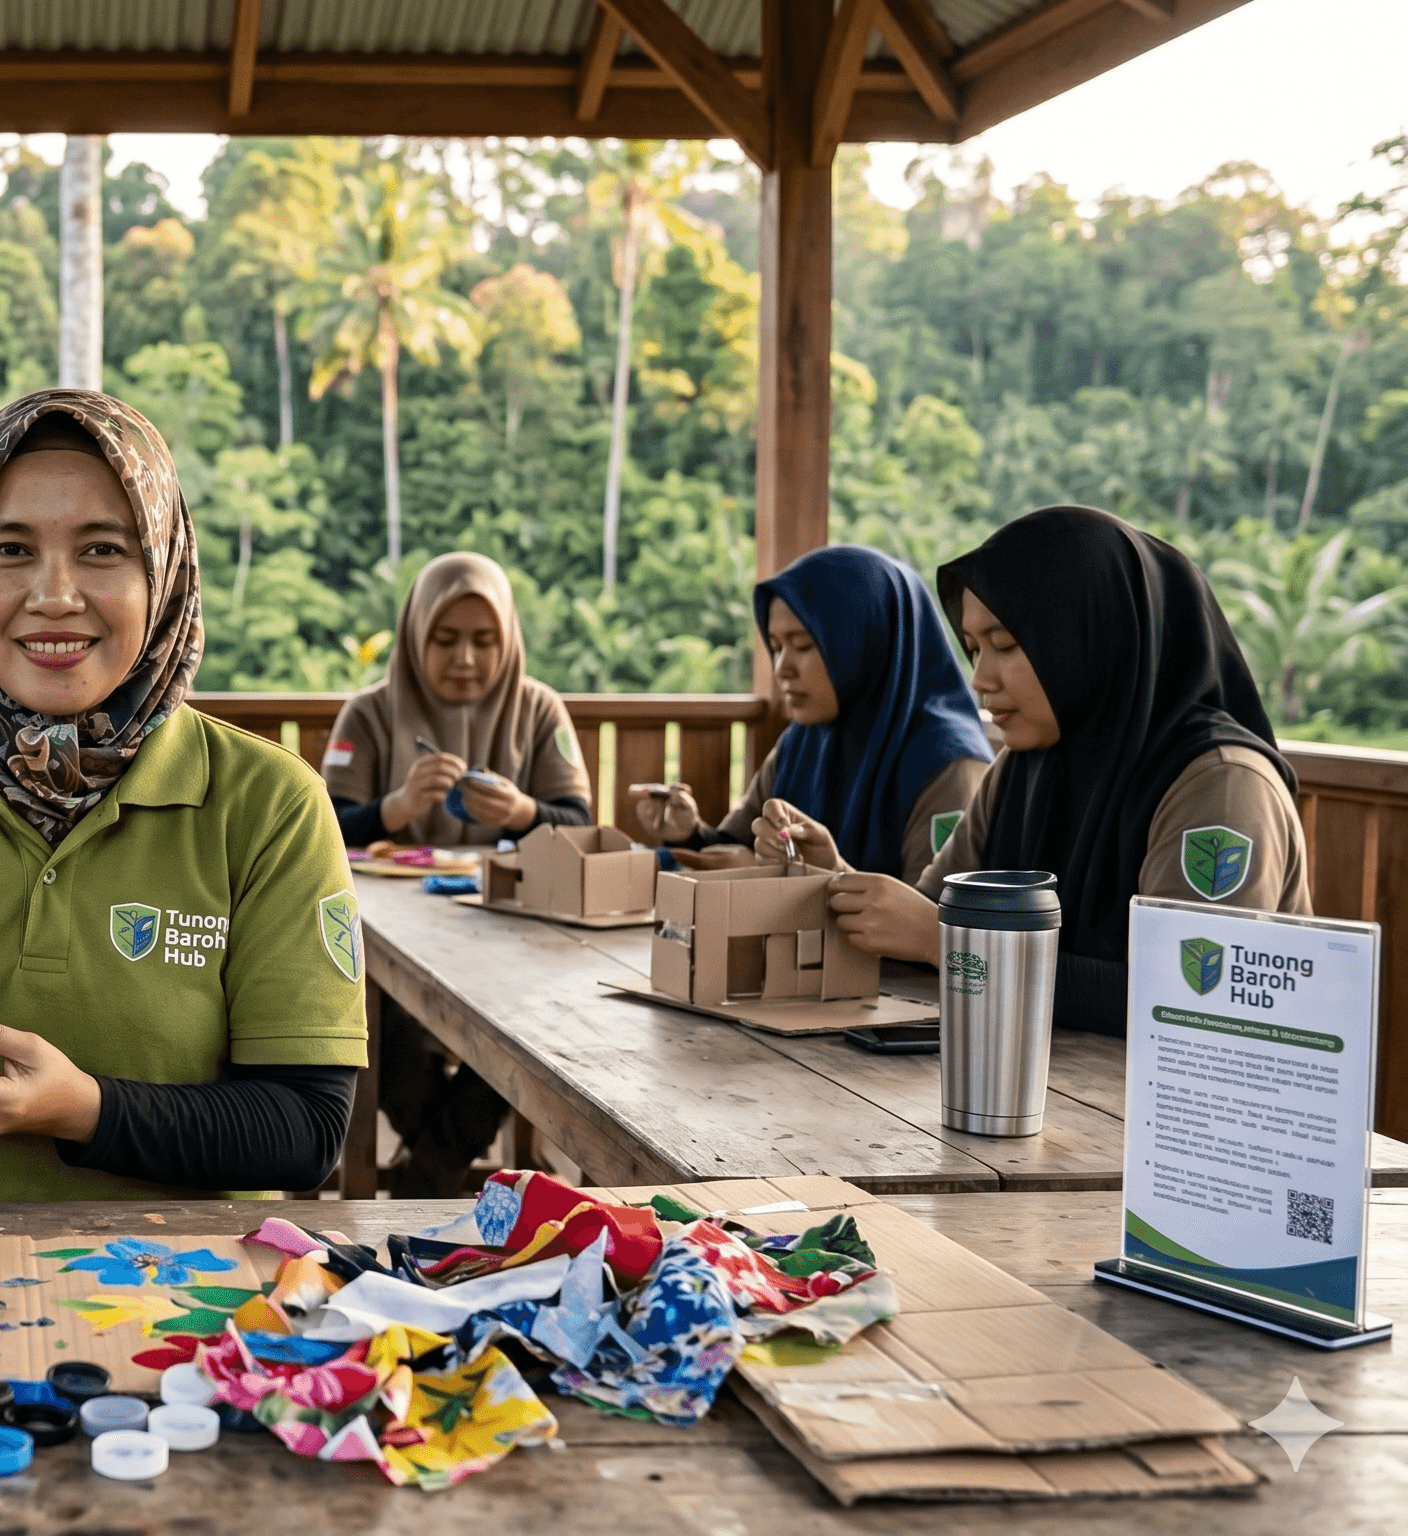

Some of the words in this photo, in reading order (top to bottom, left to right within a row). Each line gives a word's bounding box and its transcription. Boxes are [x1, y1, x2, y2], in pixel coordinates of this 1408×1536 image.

[166, 910, 229, 933] Tunon
[165, 928, 226, 949] Baroh
[164, 947, 206, 967] Hub
[1231, 945, 1313, 977] Tunong
[1231, 965, 1295, 992] Baroh
[1231, 985, 1274, 1008] Hub
